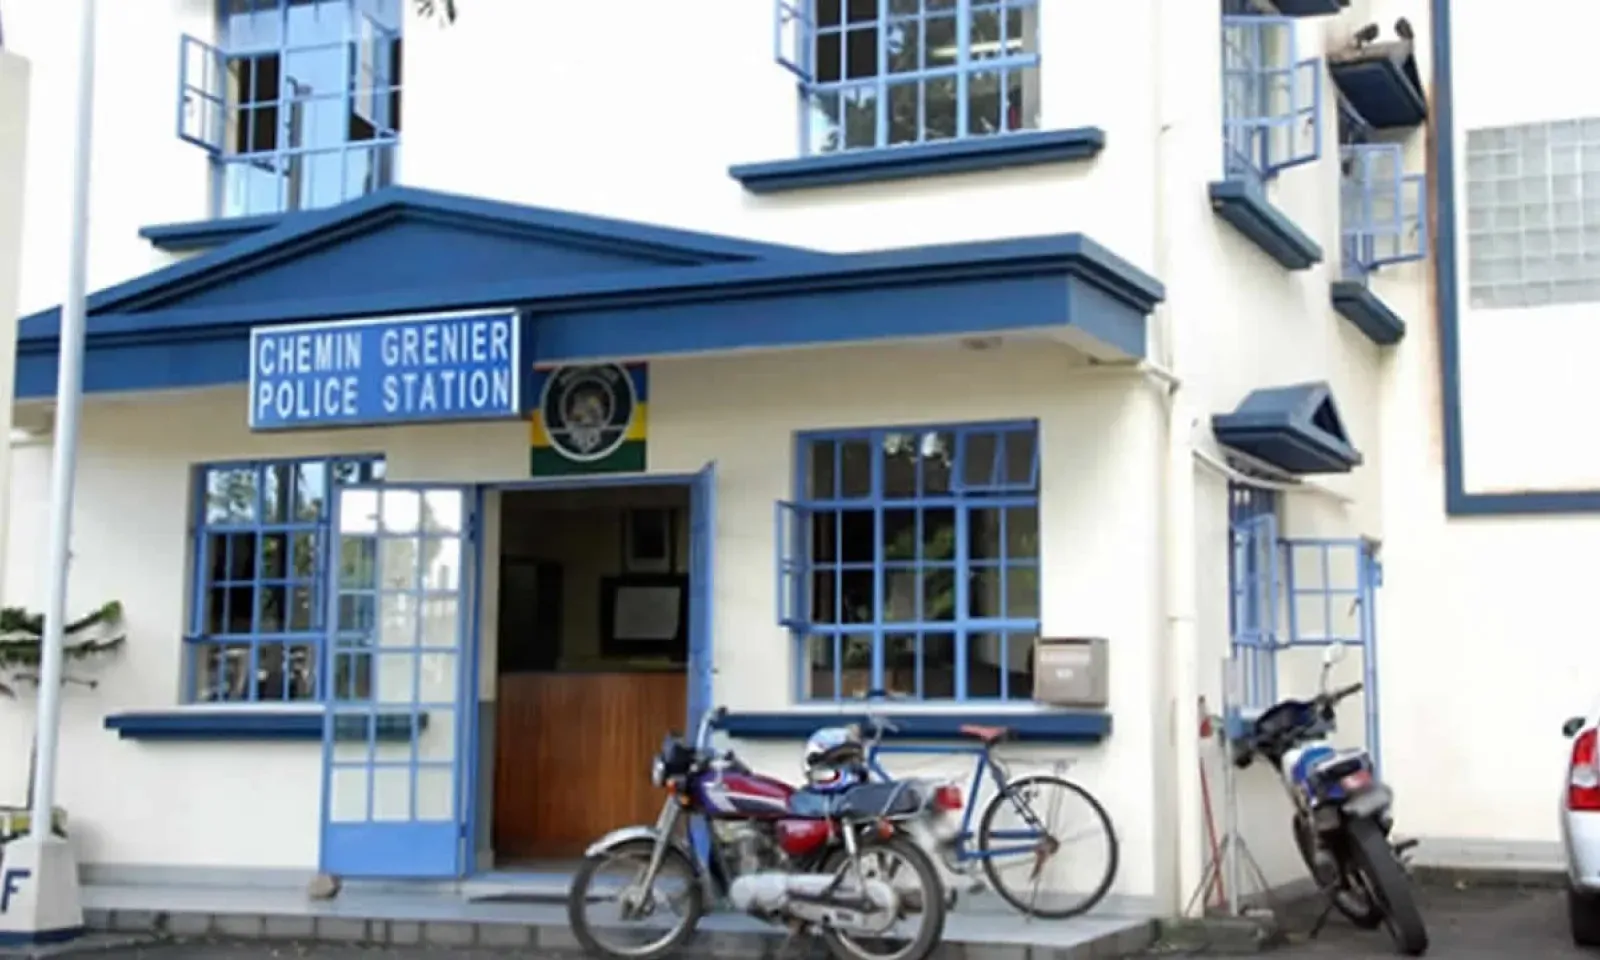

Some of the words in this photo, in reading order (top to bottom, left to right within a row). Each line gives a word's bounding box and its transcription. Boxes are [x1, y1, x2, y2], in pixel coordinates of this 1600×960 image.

[260, 331, 362, 375] CHEMIN
[382, 321, 508, 367] GRENIER
[258, 376, 359, 420] POLICE
[382, 369, 509, 413] STATION
[1, 869, 32, 914] F
